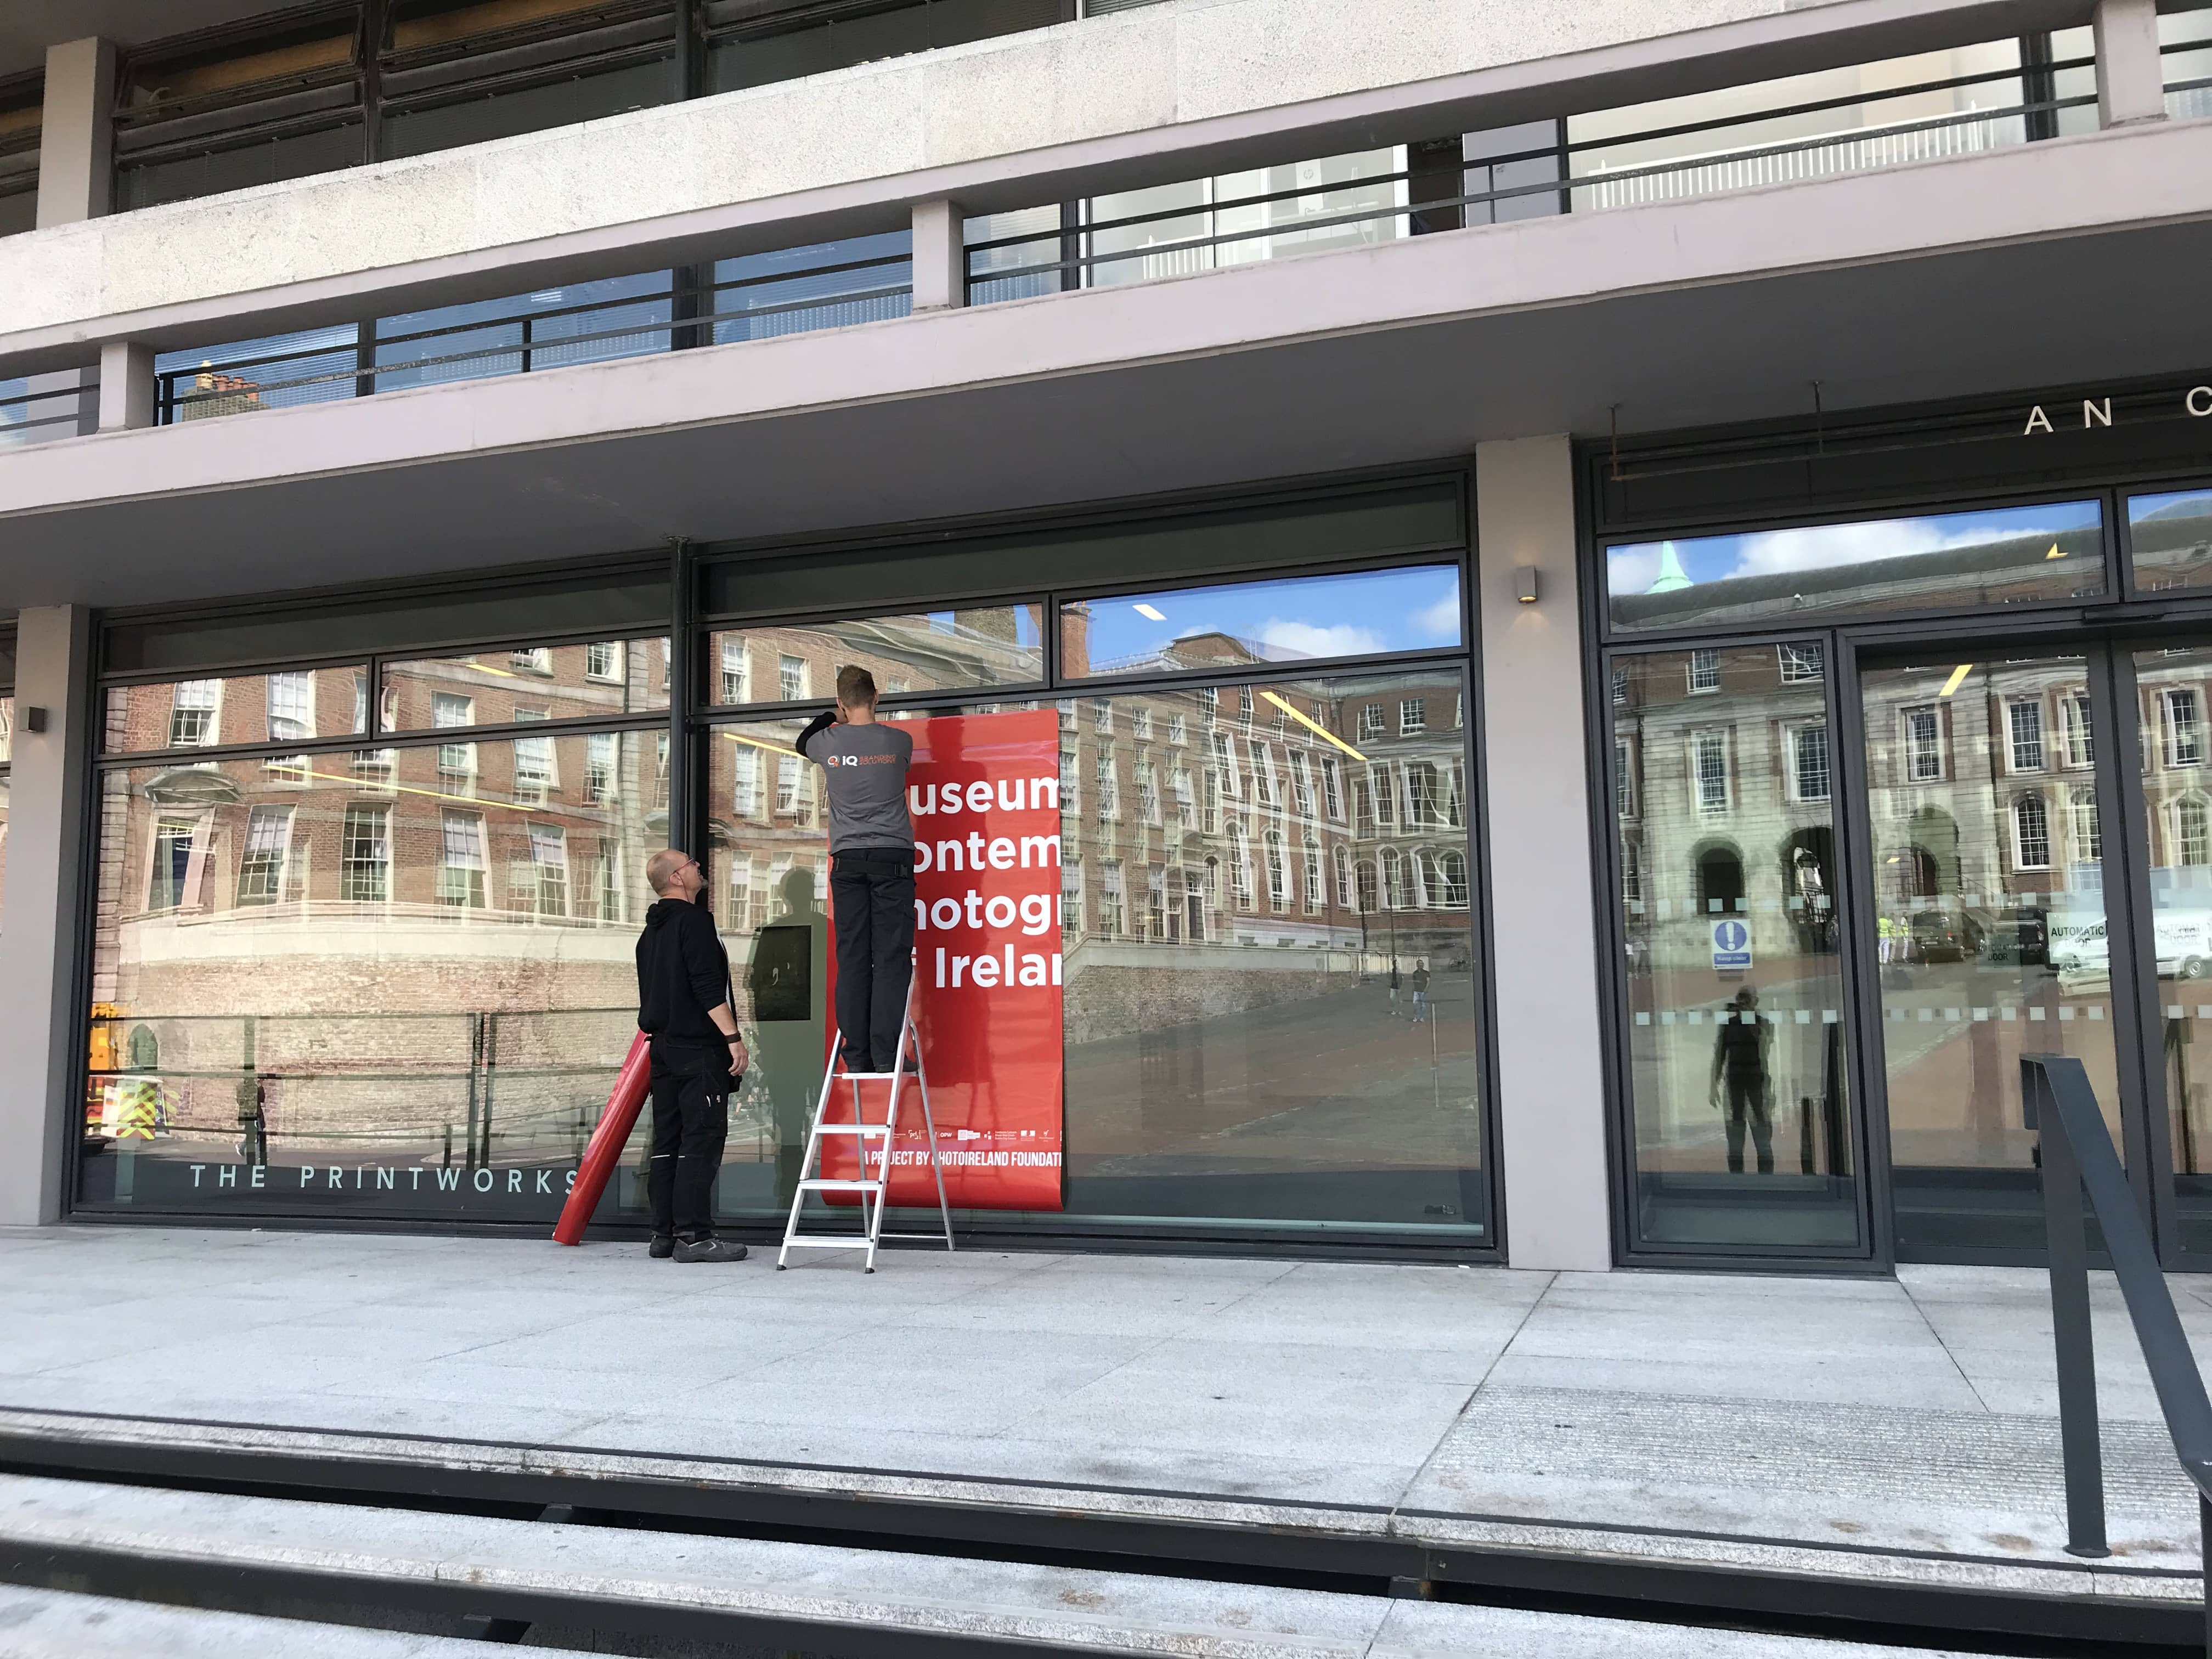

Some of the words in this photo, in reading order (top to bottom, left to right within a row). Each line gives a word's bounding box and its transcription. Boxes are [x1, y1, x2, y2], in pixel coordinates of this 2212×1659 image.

[2023, 397, 2112, 436] AN
[910, 776, 1060, 815] useum
[913, 831, 1061, 873] ontem
[2051, 926, 2104, 936] AUTOMATIC
[871, 1151, 915, 1166] PRJECT
[916, 1151, 930, 1166] BY
[932, 1151, 1008, 1166] HOTOIRELAND
[190, 1165, 266, 1188] THE
[300, 1165, 578, 1195] PRINTWORKS
